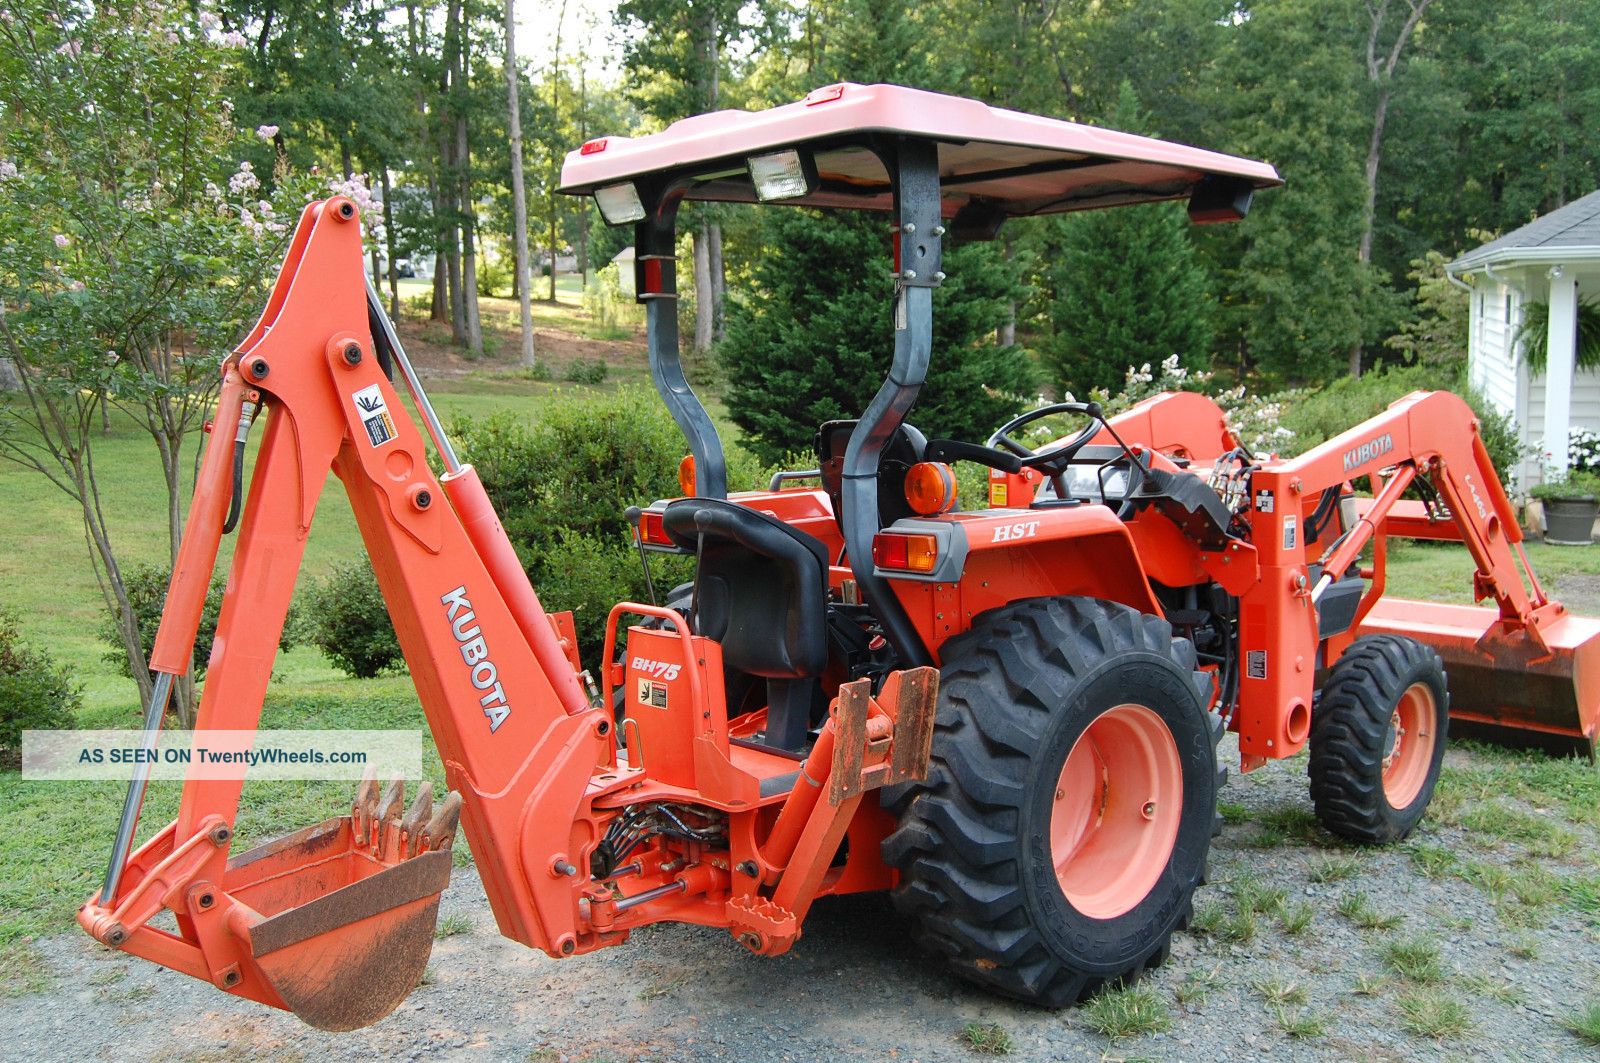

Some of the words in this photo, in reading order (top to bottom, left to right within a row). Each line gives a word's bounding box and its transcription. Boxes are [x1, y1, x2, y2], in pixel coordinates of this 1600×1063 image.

[1343, 432, 1393, 473] KUBOTA
[992, 521, 1040, 543] HST
[440, 584, 512, 735] KUBOTA
[631, 656, 682, 681] BH75
